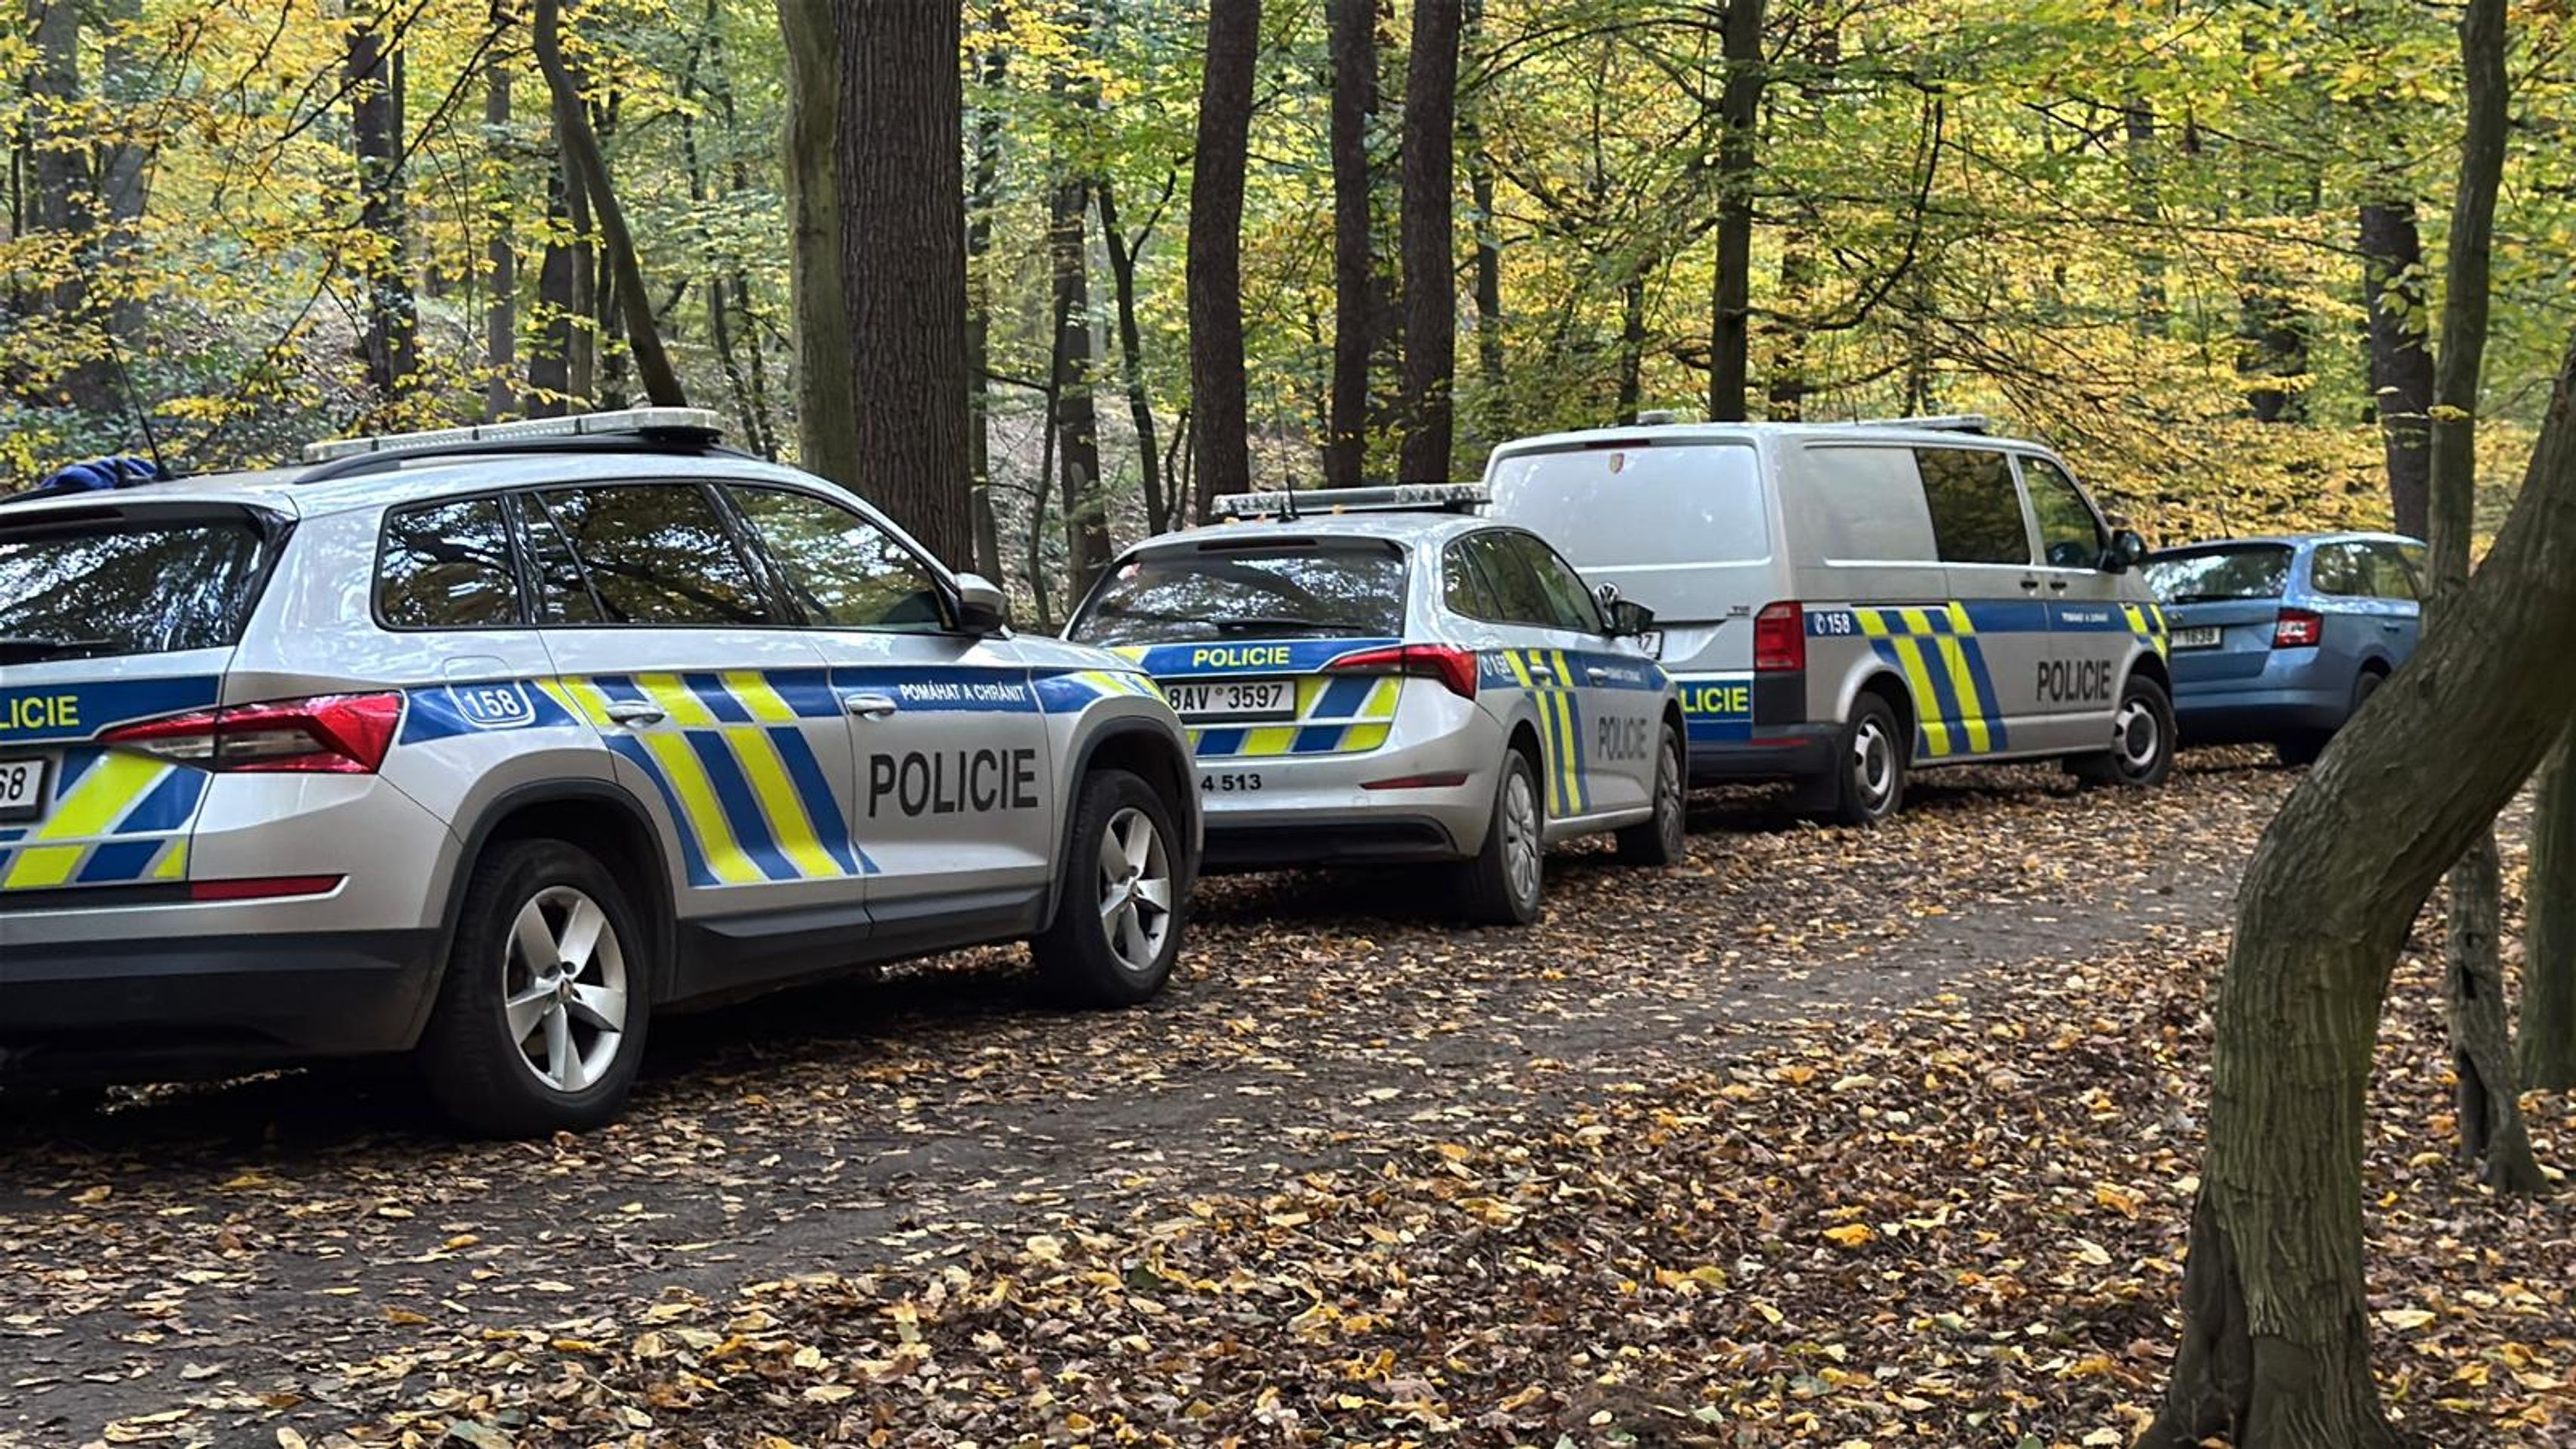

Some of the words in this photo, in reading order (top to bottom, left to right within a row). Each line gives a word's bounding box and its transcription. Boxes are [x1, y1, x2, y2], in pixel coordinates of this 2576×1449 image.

[1827, 613, 1851, 634] 158
[1193, 647, 1291, 668] POLICIE
[900, 680, 960, 700] POMÁHAT
[963, 684, 974, 700] A
[974, 681, 1026, 702] CHRÁNIT
[2037, 660, 2111, 702] POLICIE
[464, 689, 521, 717] 158
[1169, 686, 1209, 711] 8AV
[1228, 684, 1283, 709] 3597
[869, 748, 1038, 818] POLICIE
[1222, 774, 1262, 791] 513
